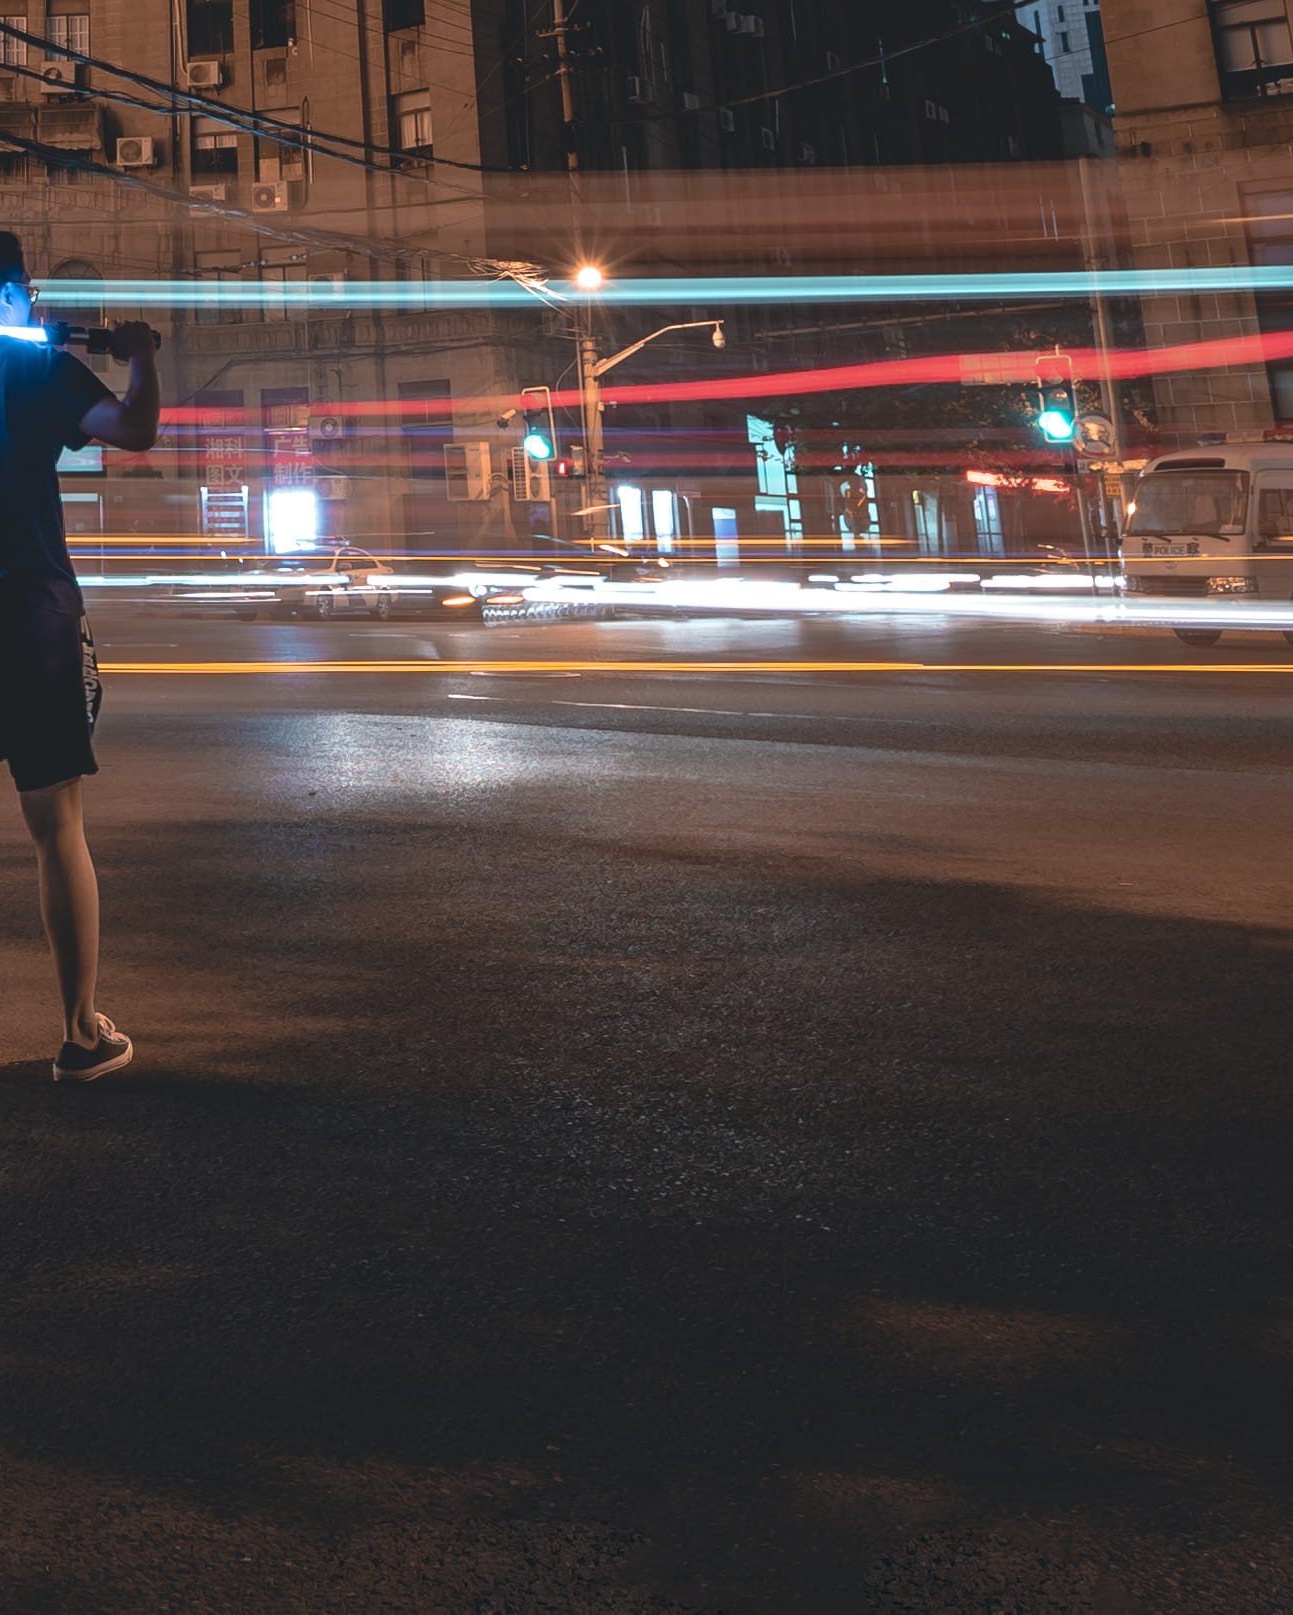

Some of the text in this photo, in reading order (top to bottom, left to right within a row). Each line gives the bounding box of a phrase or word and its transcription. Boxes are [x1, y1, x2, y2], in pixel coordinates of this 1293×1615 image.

[273, 435, 308, 458] 广告
[206, 463, 244, 486] 图文
[273, 462, 313, 485] 制作
[1155, 545, 1184, 555] POLICE
